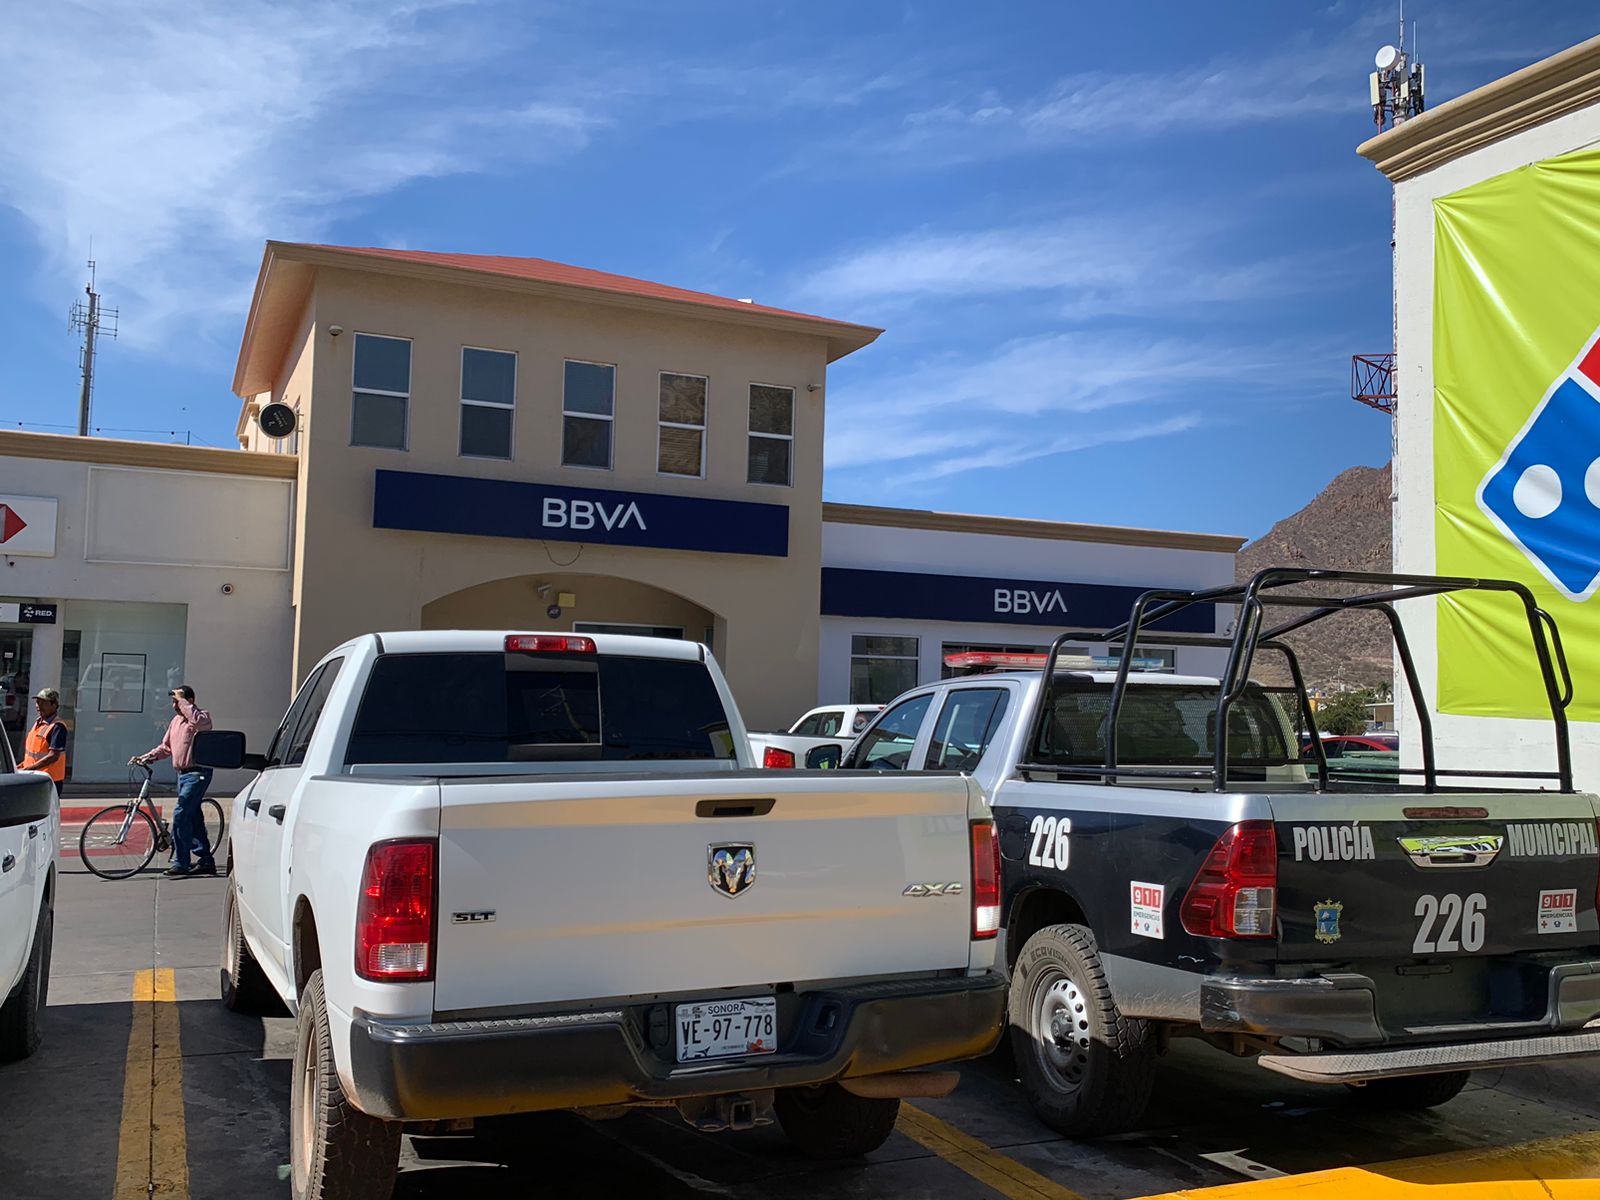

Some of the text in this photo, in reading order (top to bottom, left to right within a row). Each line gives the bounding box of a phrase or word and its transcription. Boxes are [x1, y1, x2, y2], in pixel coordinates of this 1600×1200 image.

[542, 497, 647, 531] BBVA
[994, 588, 1068, 614] BBVA
[1028, 815, 1071, 871] 226
[1293, 820, 1598, 861] POLICÍA MUNICIPAL
[1135, 889, 1160, 906] 911
[1543, 895, 1572, 907] 911
[453, 911, 496, 922] SLT
[1412, 892, 1488, 954] 226
[708, 1003, 746, 1015] SONORA
[681, 1014, 773, 1046] VE-97-778
